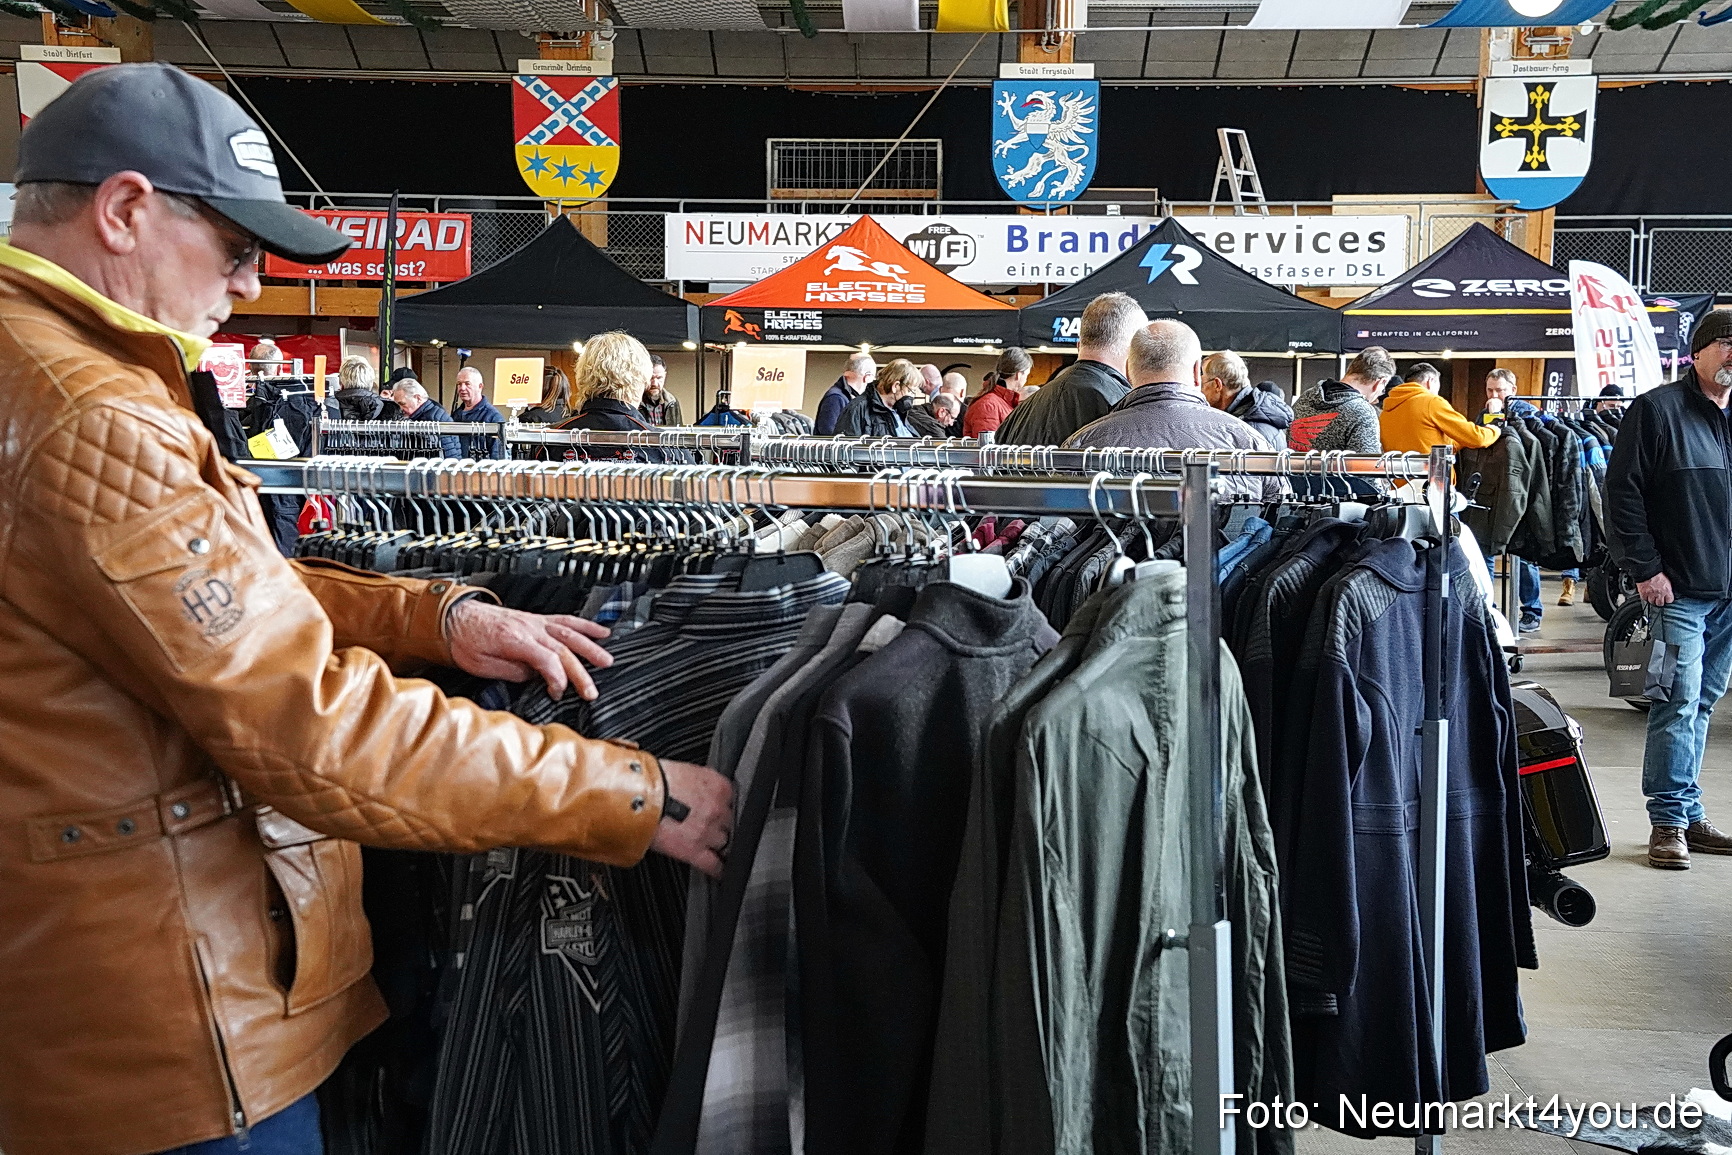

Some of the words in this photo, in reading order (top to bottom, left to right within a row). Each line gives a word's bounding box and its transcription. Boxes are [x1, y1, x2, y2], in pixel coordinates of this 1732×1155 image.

[43, 49, 63, 57] Stadt
[532, 62, 564, 71] Gemeinde
[566, 62, 592, 73] Deining
[1019, 66, 1039, 75] Stadt
[1042, 67, 1075, 77] Freystadt
[928, 226, 952, 234] FREE
[1006, 223, 1158, 254] Brand
[327, 262, 362, 275] was
[1006, 262, 1094, 277] einfach
[1346, 263, 1386, 277] DSL
[805, 281, 926, 293] ELECTRIC
[1459, 278, 1572, 293] ZERO
[804, 290, 926, 304] HORSES
[764, 310, 823, 320] ELECTRIC
[764, 319, 823, 331] HORSES
[509, 373, 530, 385] Sale
[755, 367, 785, 381] Sale
[181, 579, 232, 623] H-D
